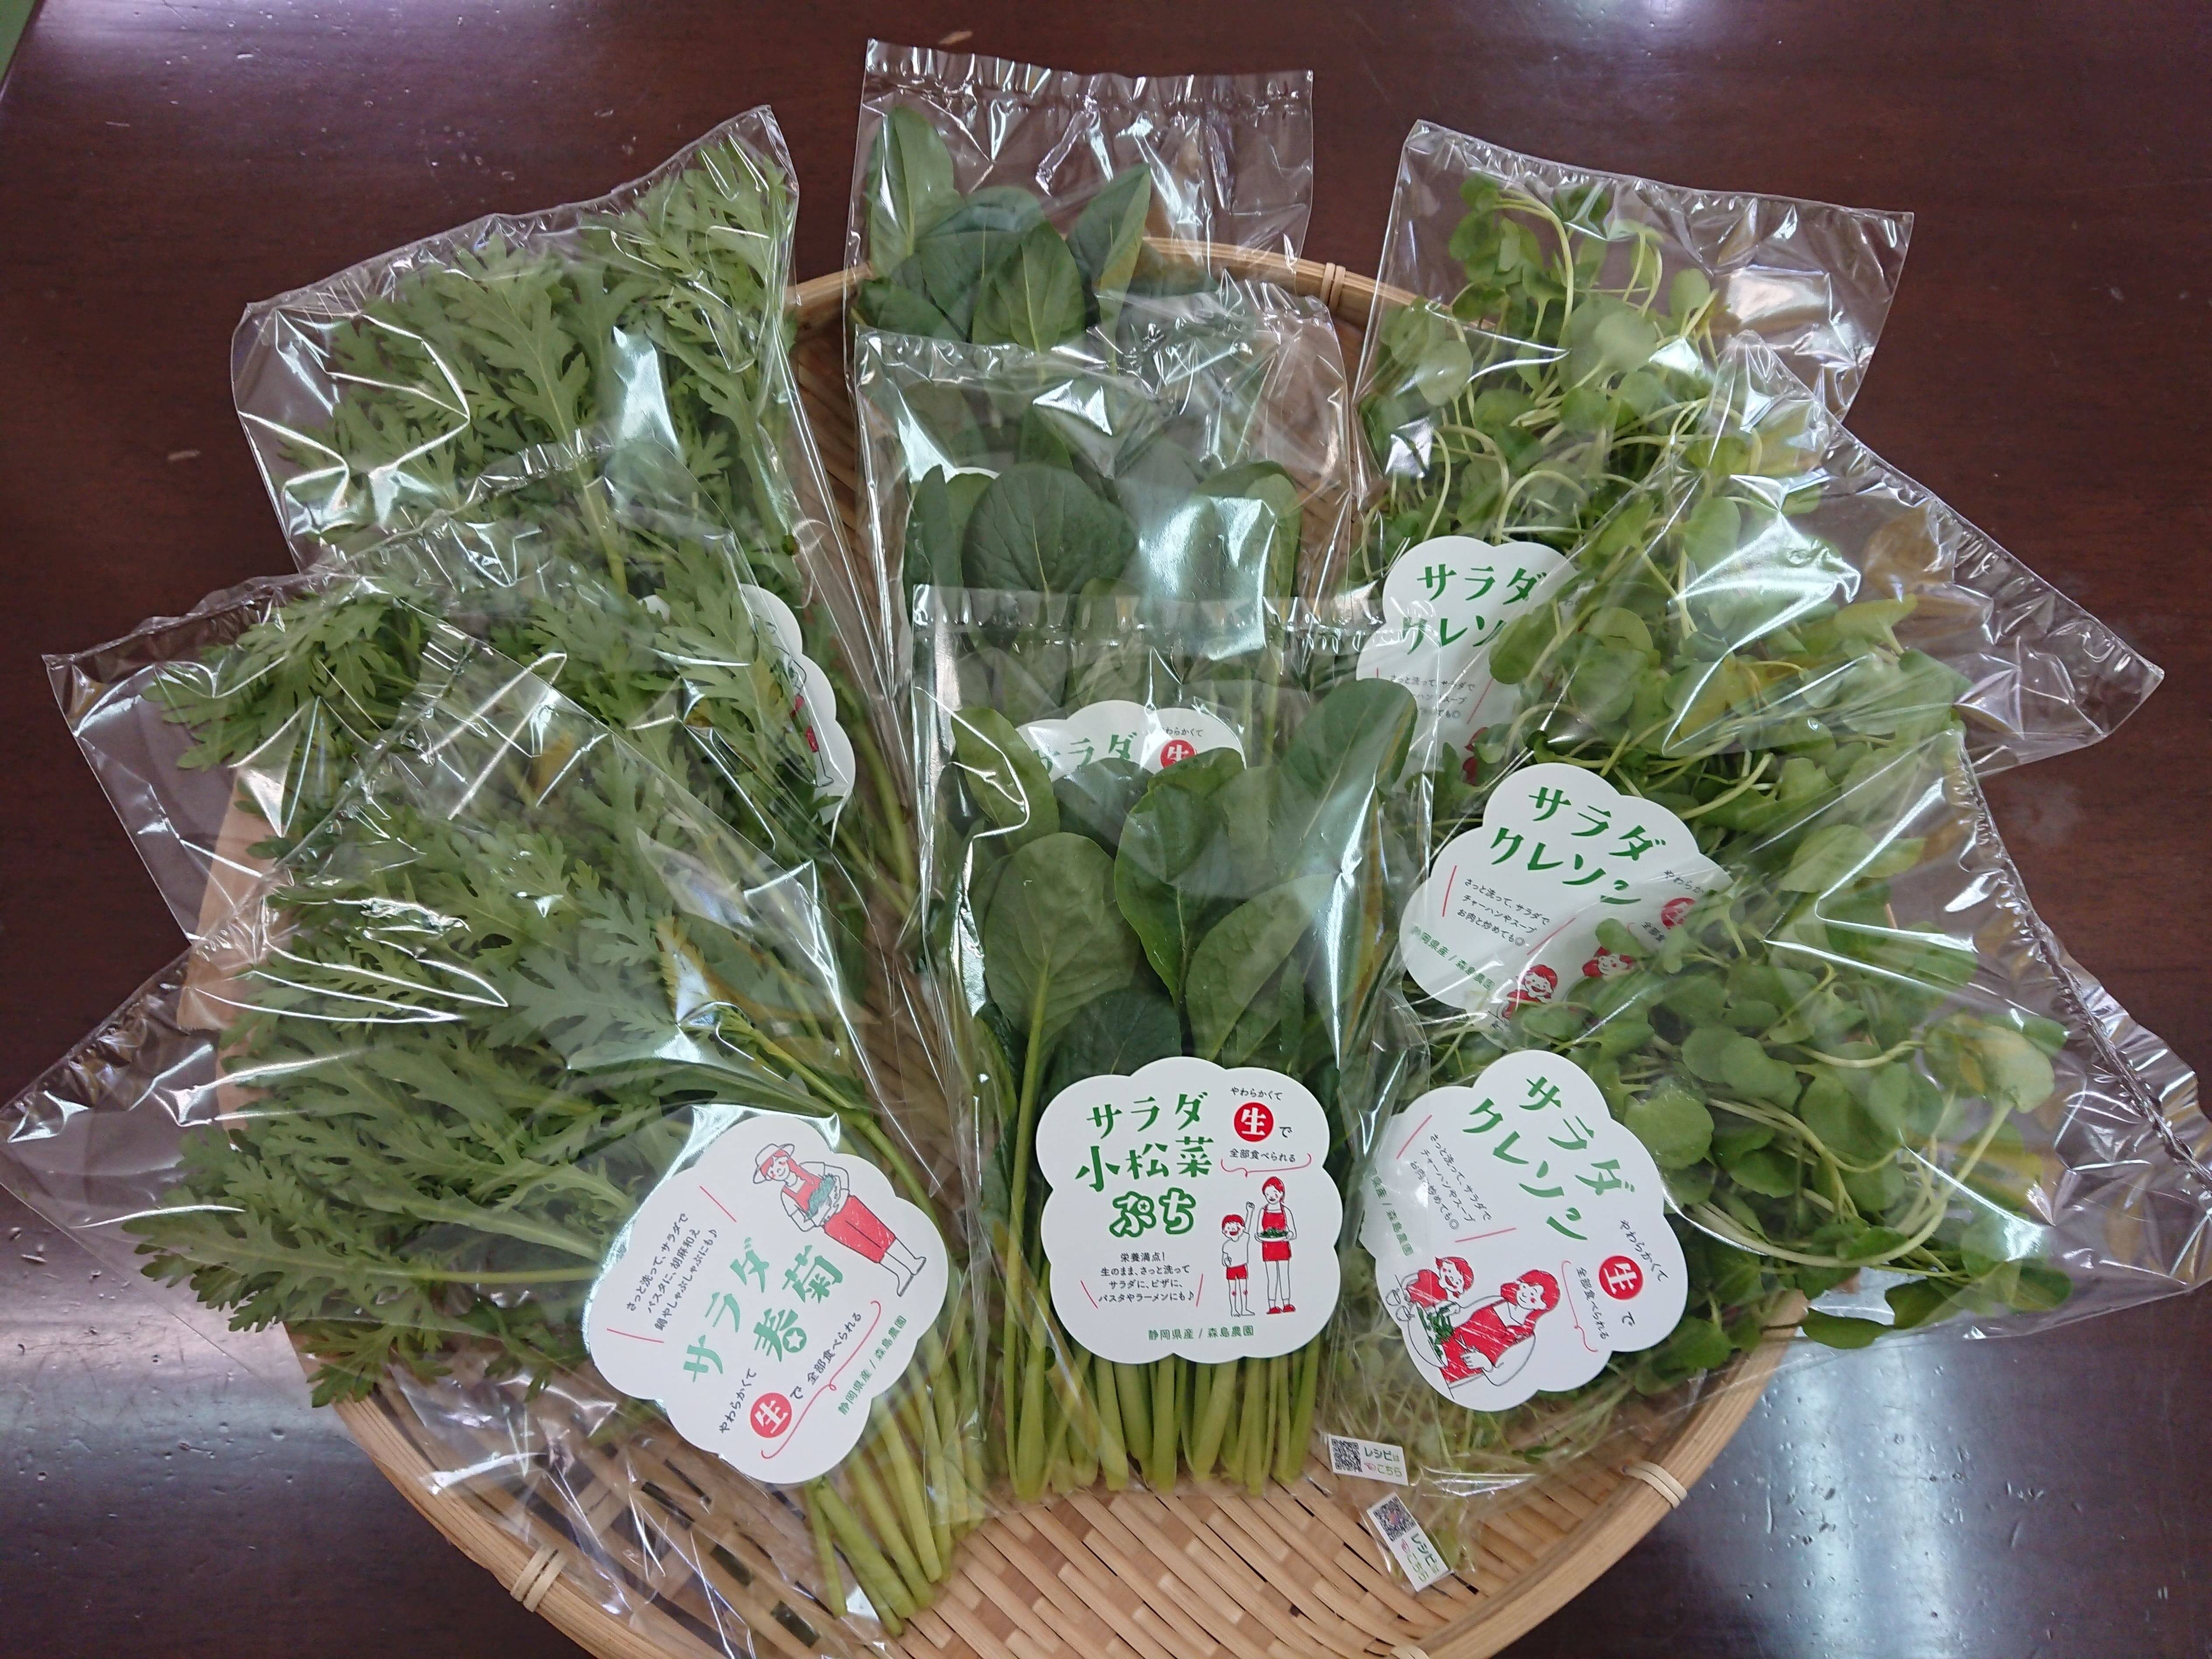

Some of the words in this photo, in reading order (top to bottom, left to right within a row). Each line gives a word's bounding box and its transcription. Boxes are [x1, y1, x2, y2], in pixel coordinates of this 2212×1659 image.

[1417, 564, 1547, 605] サラダ
[1403, 615, 1506, 654] クレソ
[1162, 726, 1203, 737] わらかくて
[1528, 787, 1666, 861] サラダ
[1490, 827, 1642, 904] クレソン
[1664, 870, 1704, 893] やわらか
[1462, 894, 1537, 933] チャーハンやスープ
[1086, 1092, 1208, 1139] サラダ
[1230, 1086, 1283, 1100] やわらかくて
[1229, 1148, 1295, 1162] 全部食べられる
[1519, 1076, 1635, 1196] サラダ
[1075, 1136, 1214, 1192] 小松菜
[1421, 1148, 1476, 1222] チャーハンやスープ
[1463, 1098, 1588, 1241] クレソン
[1109, 1187, 1197, 1238] ぷち
[1100, 1264, 1190, 1277] 生のまま、さっと洗って
[1120, 1251, 1166, 1263] 栄養満点！
[1620, 1219, 1669, 1282] やわらかくて
[682, 1236, 770, 1383] サラダ
[1576, 1267, 1610, 1340] 全部食べられる
[719, 1368, 757, 1434] やわらかくて
[1377, 1464, 1403, 1477] こちら
